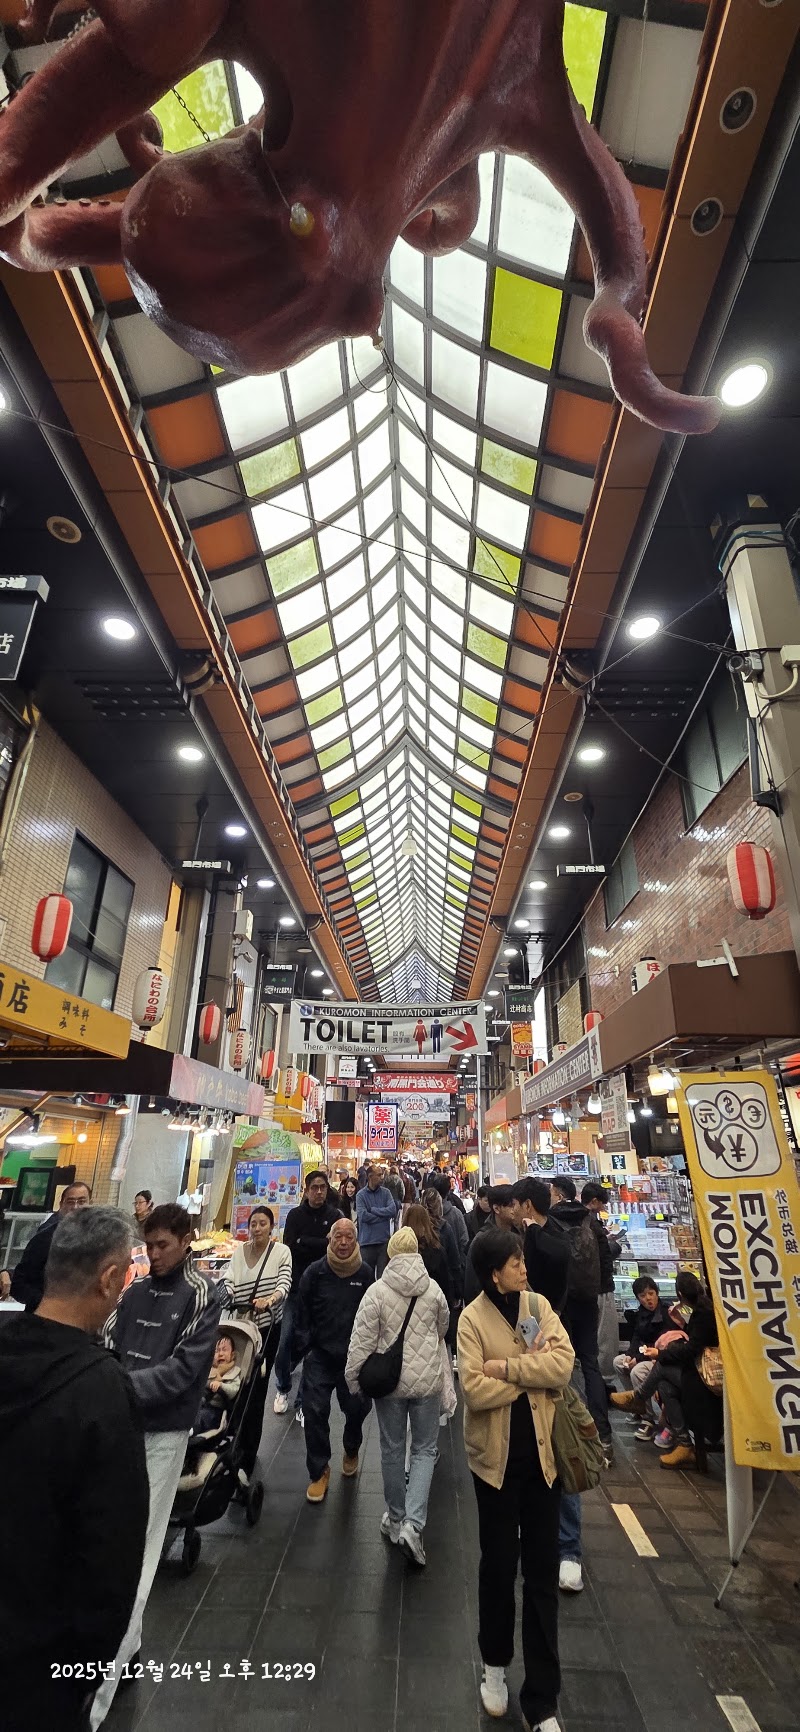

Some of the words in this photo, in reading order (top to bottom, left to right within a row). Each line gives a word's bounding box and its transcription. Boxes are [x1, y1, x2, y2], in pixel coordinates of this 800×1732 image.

[0, 972, 31, 1014] 店
[143, 973, 163, 1022] なにわの台所
[62, 998, 91, 1022] 調味料
[319, 1008, 367, 1017] KUROMON
[371, 1008, 435, 1017] INFORMATION
[440, 1006, 473, 1016] CENTER
[59, 1017, 87, 1037] みそ
[300, 1019, 393, 1043] TOILET
[304, 1043, 324, 1051] There
[353, 1044, 390, 1052] lavatories.
[570, 1048, 590, 1080] CENTER
[375, 1106, 391, 1123] 薬
